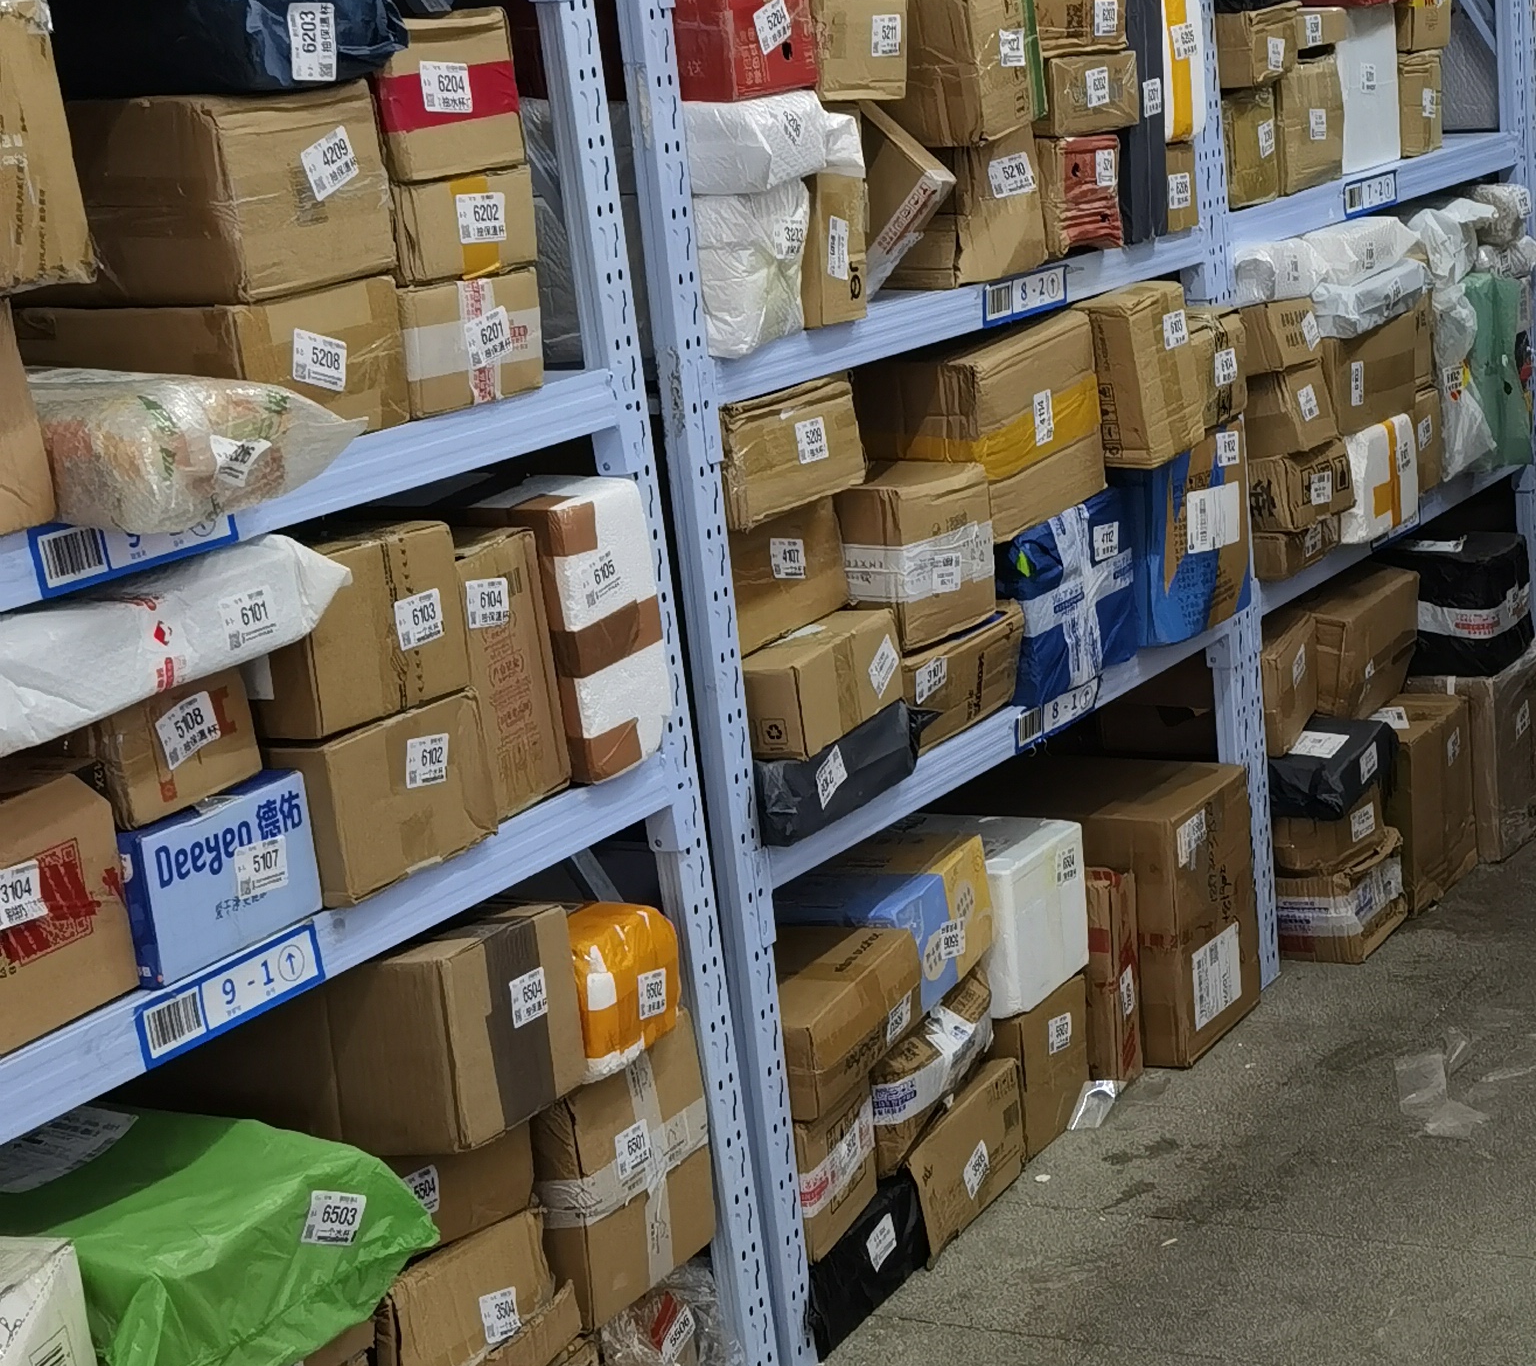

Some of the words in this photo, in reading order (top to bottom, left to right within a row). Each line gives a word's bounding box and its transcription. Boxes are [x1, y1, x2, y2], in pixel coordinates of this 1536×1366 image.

[767, 9, 787, 30] 5204
[300, 11, 316, 53] 6203
[882, 26, 897, 40] 5211
[438, 75, 465, 92] 6204
[322, 139, 349, 165] 4209
[1003, 162, 1025, 179] 5210
[473, 206, 499, 222] 6202
[481, 323, 504, 346] 6201
[311, 347, 340, 370] 5208
[805, 427, 822, 444] 5209
[782, 549, 800, 564] 4107
[594, 559, 615, 585] 6105
[480, 591, 502, 607] 6104
[240, 601, 269, 626] 6101
[412, 602, 436, 626] 6103
[175, 708, 204, 737] 5108
[421, 747, 443, 766] 6102
[256, 790, 303, 840] 德佑
[253, 849, 279, 872] 5107
[1, 878, 32, 904] 3104
[522, 981, 543, 1003] 6504
[321, 1206, 357, 1225] 6503
[495, 1303, 515, 1321] 3504
